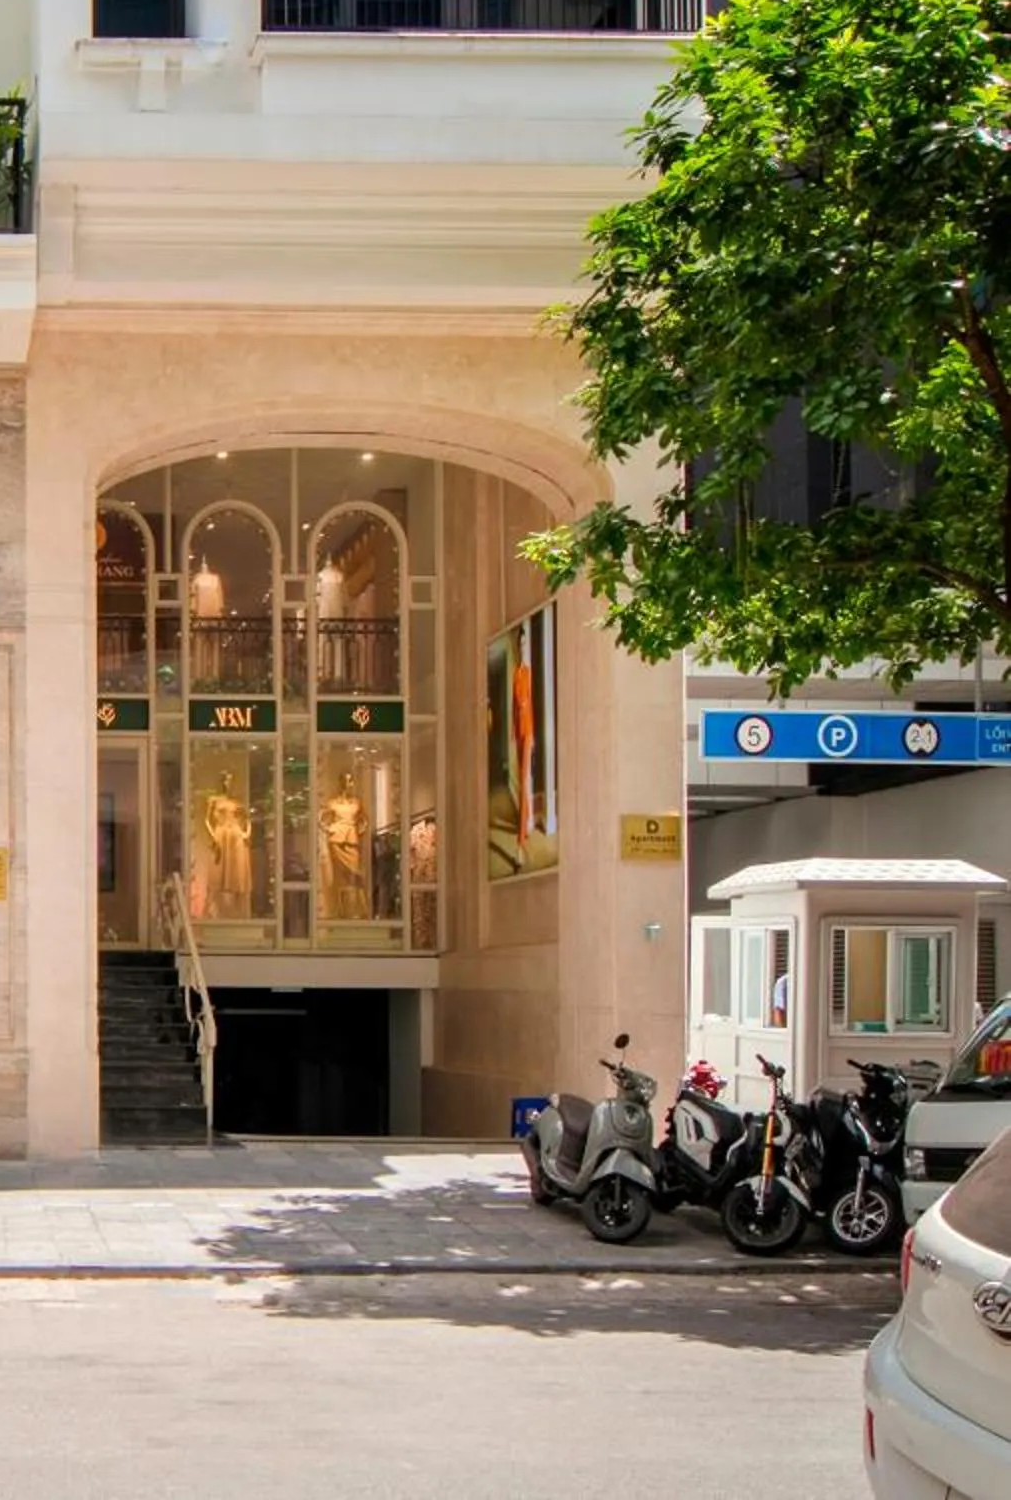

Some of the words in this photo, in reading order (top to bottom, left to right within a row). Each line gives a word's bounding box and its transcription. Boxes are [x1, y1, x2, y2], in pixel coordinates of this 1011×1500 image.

[748, 725, 762, 747] 5
[831, 727, 846, 747] P
[646, 819, 659, 834] D
